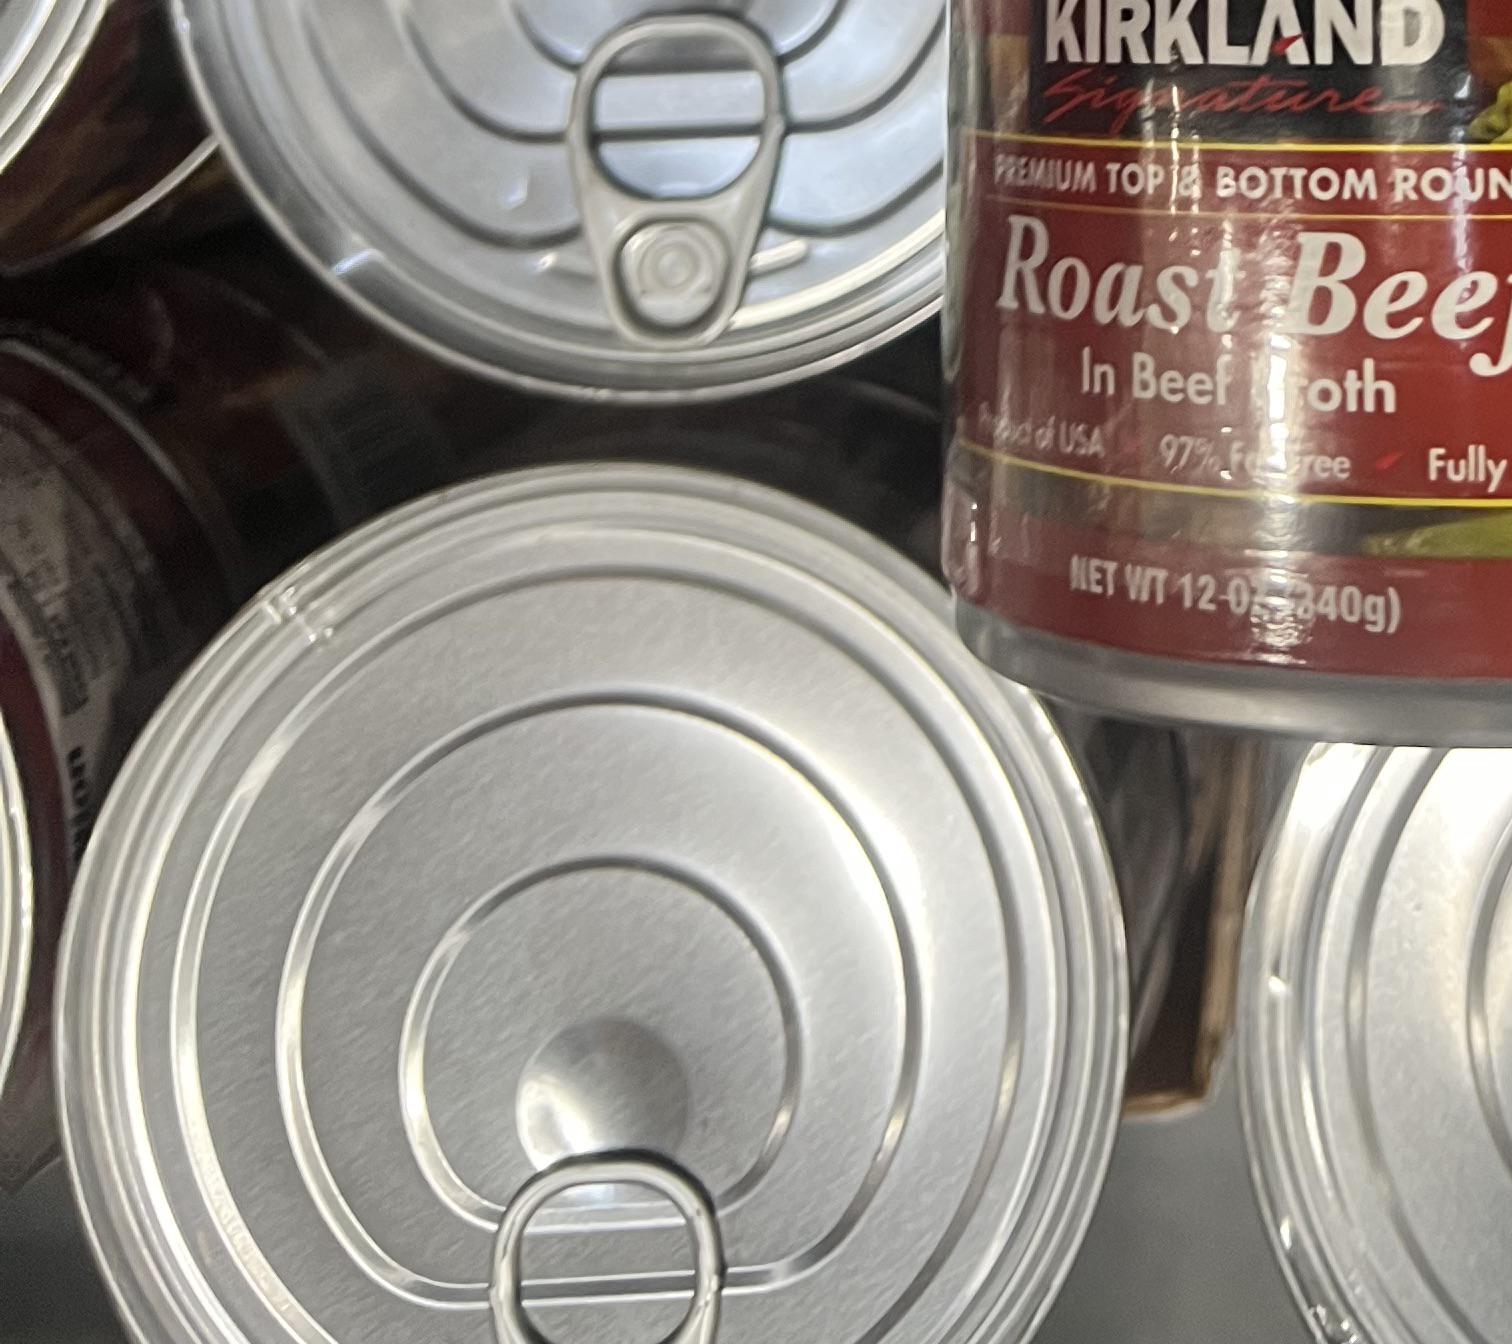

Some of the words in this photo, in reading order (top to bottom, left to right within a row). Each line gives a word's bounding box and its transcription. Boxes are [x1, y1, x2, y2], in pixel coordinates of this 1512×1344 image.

[993, 153, 1098, 194] PREMIUM
[1105, 162, 1166, 196] TOP
[1215, 165, 1379, 202] BOTTOM
[995, 214, 1247, 333] Roast
[1080, 345, 1116, 396] In
[1131, 351, 1234, 406] Beef
[1059, 420, 1107, 459] USA
[1428, 446, 1504, 493] Fully
[1068, 553, 1119, 597] NET
[1123, 562, 1170, 609] WT
[1177, 570, 1218, 612] 12
